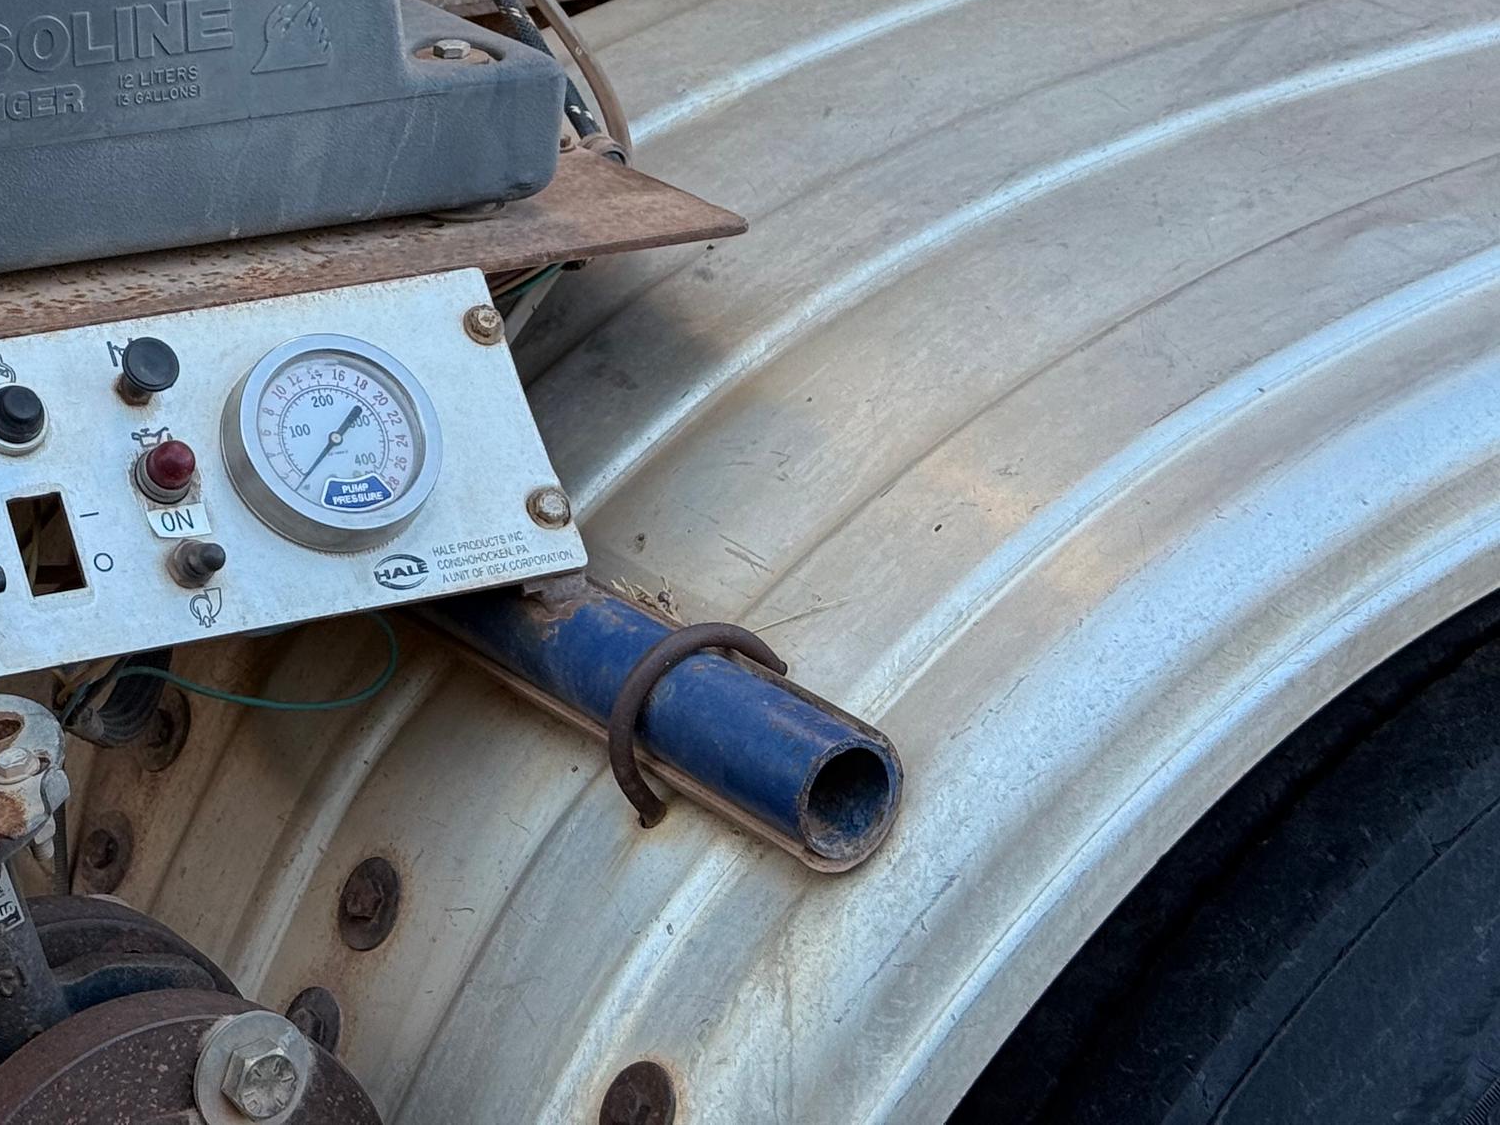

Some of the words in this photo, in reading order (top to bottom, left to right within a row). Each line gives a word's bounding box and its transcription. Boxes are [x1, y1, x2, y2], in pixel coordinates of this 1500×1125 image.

[119, 74, 134, 89] 12
[140, 65, 199, 87] LITERS
[331, 369, 346, 382] 16
[354, 375, 369, 390] 18
[270, 384, 287, 400] 10
[372, 390, 389, 407] 20
[311, 394, 334, 408] 200
[387, 410, 404, 426] 22
[289, 423, 311, 439] 100
[396, 434, 409, 448] 24
[354, 452, 377, 467] 400
[394, 456, 408, 471] 26
[342, 482, 369, 494] PUMP
[332, 491, 384, 506] PRESSURE
[160, 508, 195, 532] ON
[431, 543, 457, 557] HALE
[457, 534, 507, 552] PRODUCTS
[515, 544, 530, 555] PA
[373, 561, 430, 581] HALE
[450, 569, 470, 583] UNIT
[472, 567, 485, 578] OF
[486, 562, 509, 575] IDEX
[509, 548, 575, 571] CORPORATION
